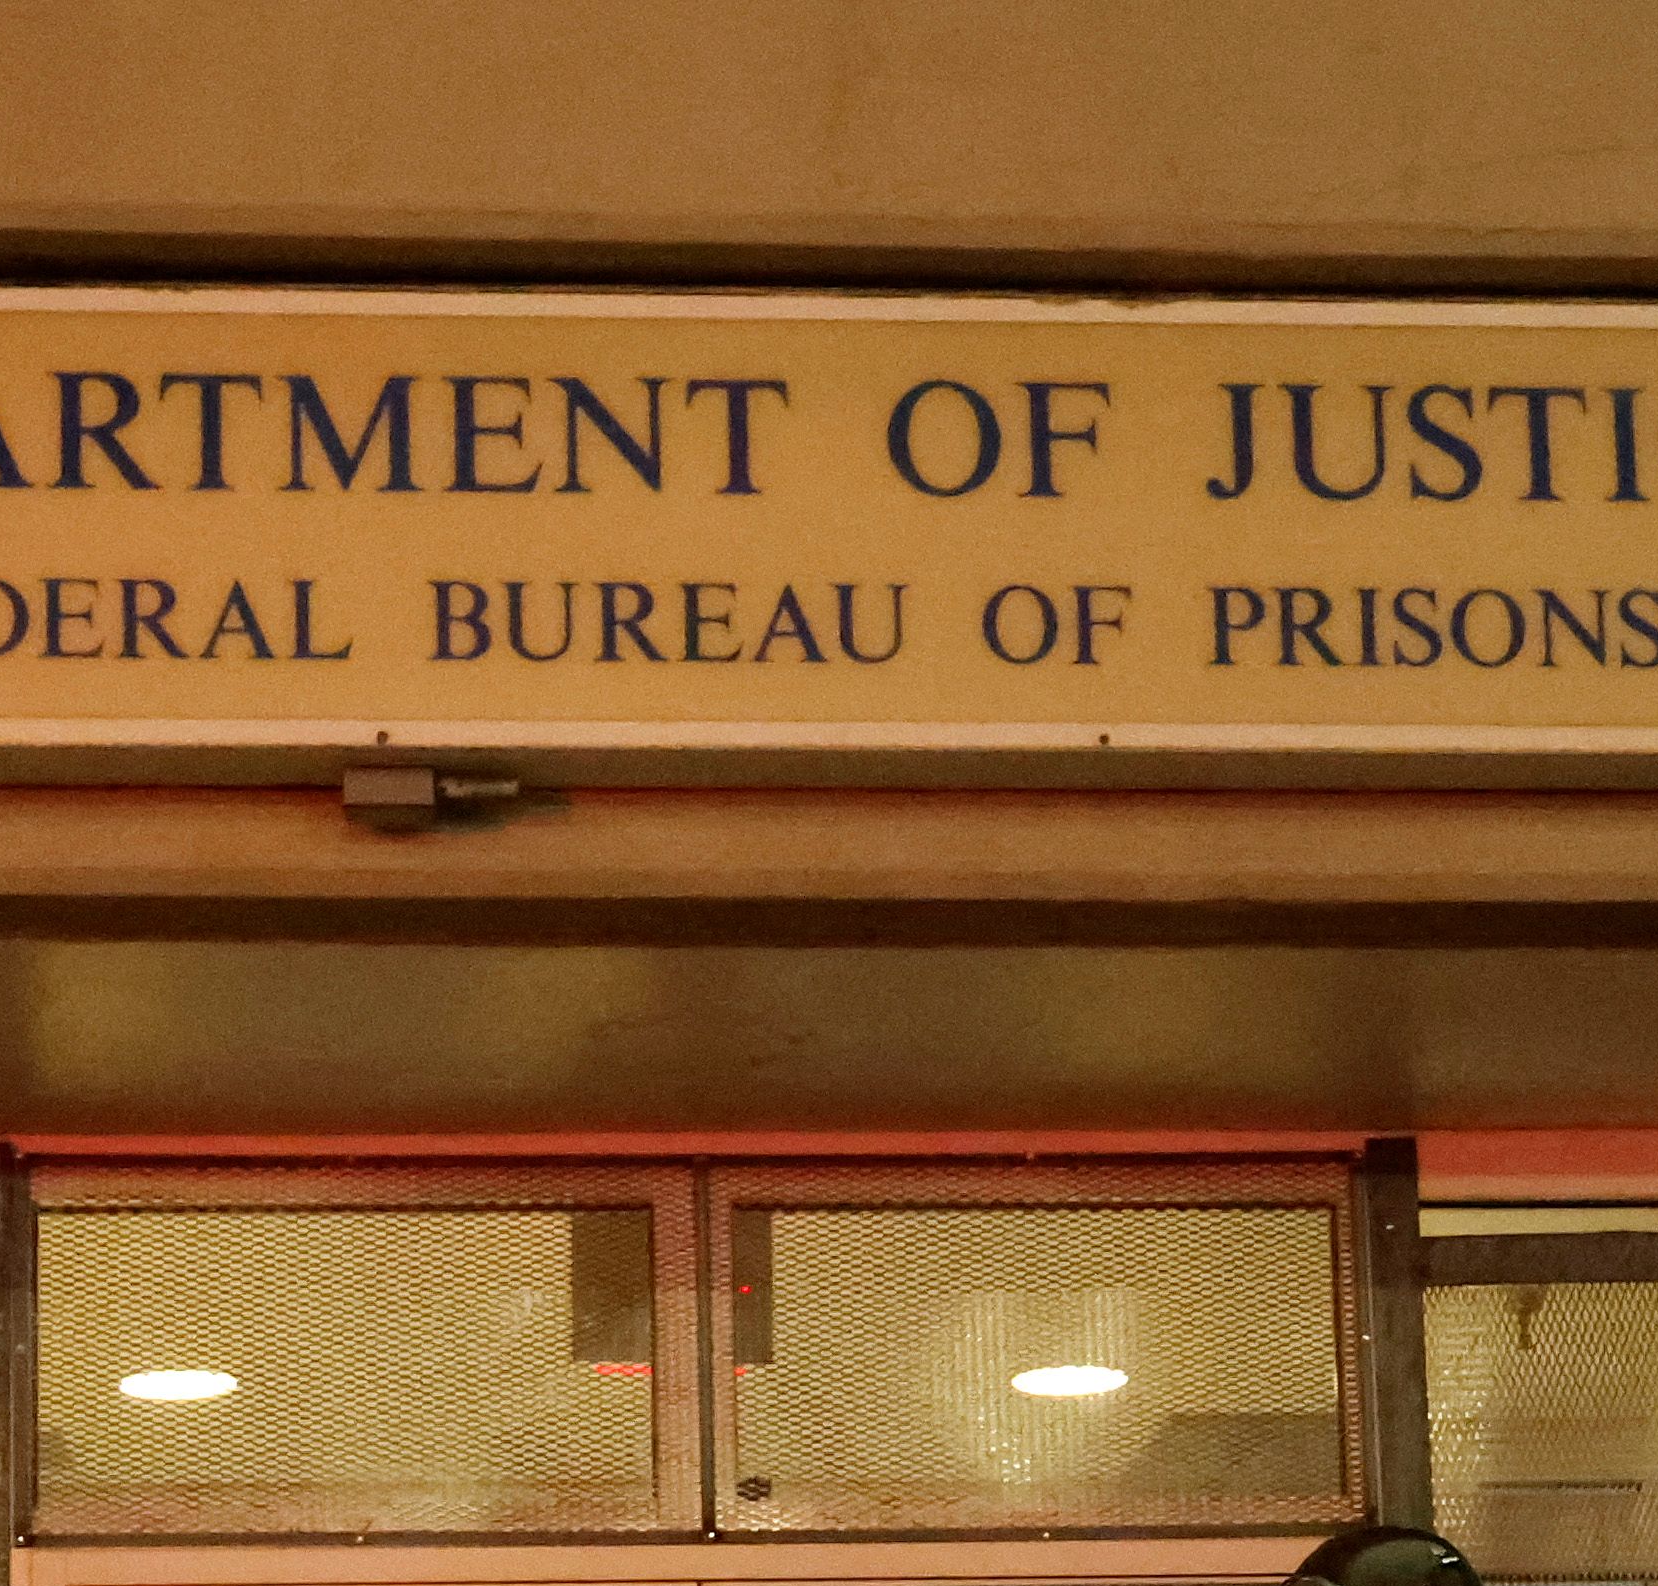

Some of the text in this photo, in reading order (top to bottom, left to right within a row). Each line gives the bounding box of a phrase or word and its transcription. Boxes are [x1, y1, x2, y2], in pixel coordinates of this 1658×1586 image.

[885, 376, 1112, 499] OF
[428, 579, 908, 665] BUREAU
[981, 583, 1133, 666] OF
